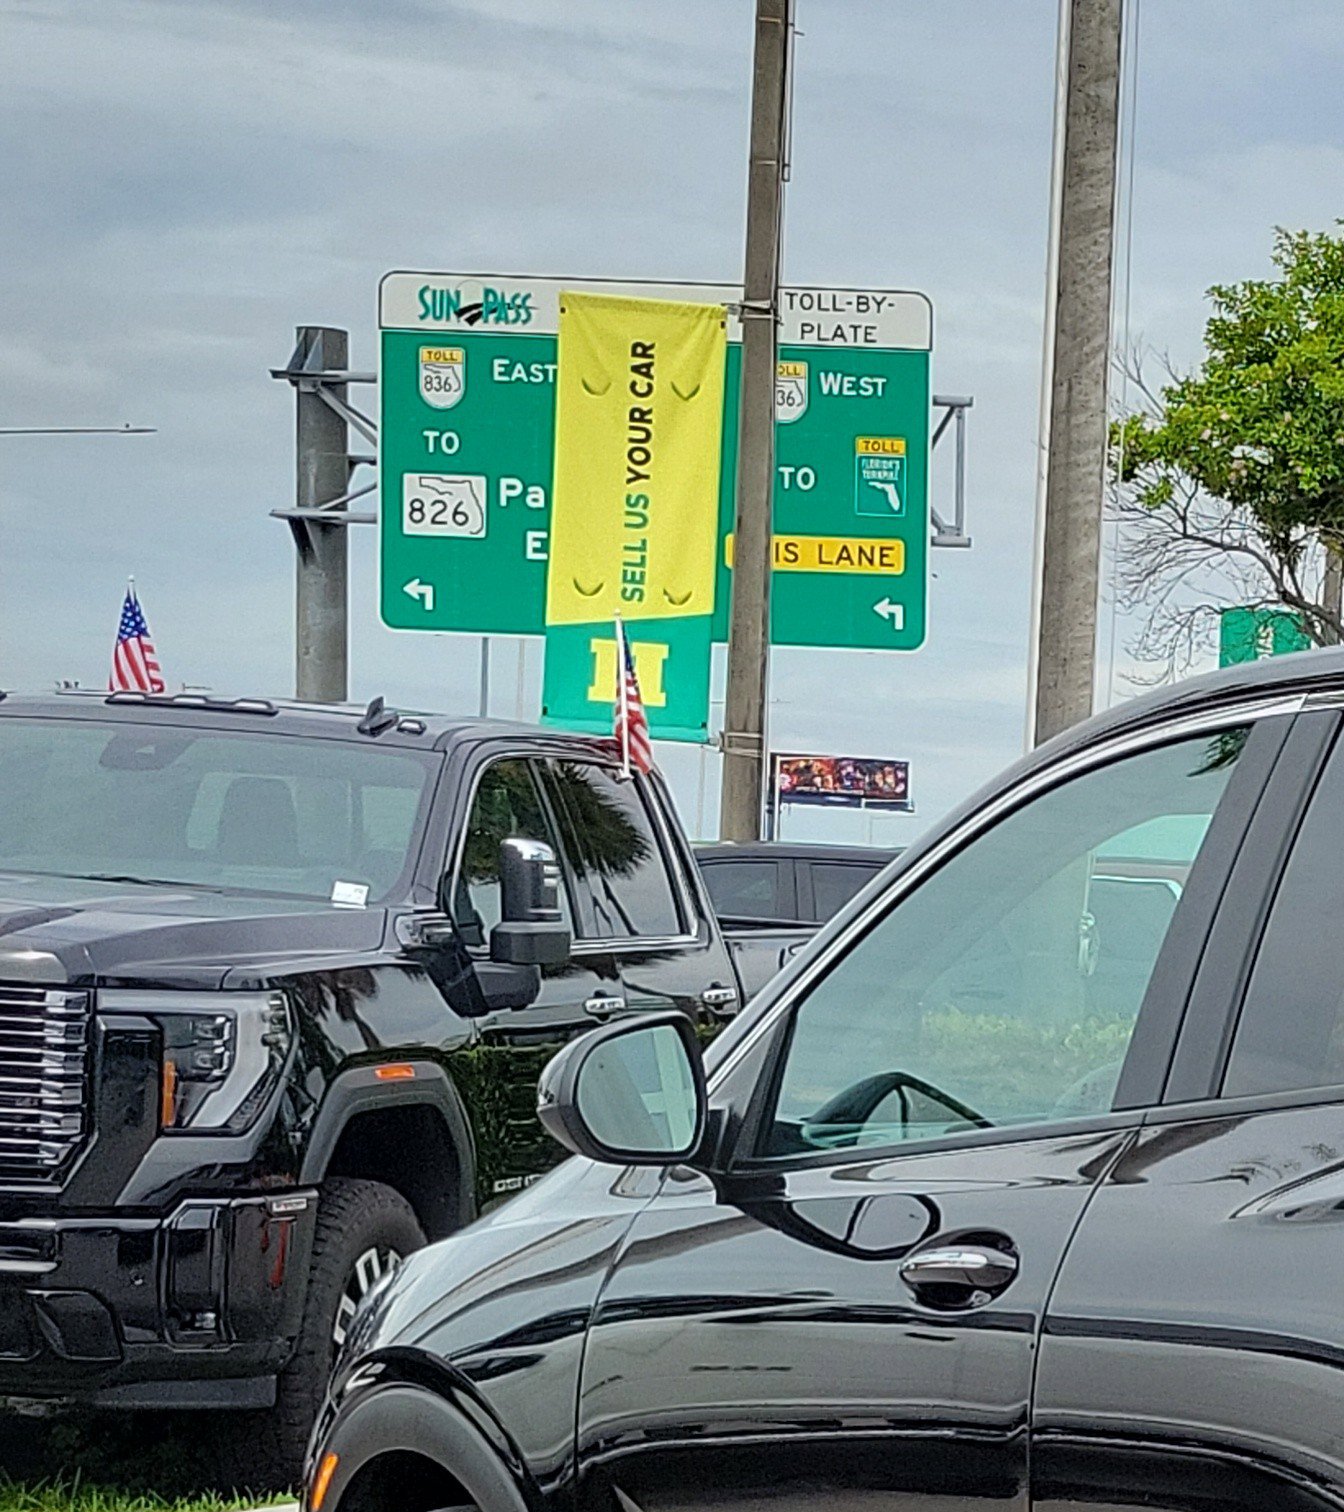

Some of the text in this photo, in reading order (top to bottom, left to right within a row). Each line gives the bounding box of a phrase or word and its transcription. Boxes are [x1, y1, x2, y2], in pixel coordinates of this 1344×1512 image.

[418, 285, 532, 325] SUN PASS
[785, 292, 895, 313] TOLL-BY-
[800, 323, 877, 343] PLATE
[426, 351, 458, 361] TOLL
[493, 358, 557, 383] EAST
[778, 366, 801, 375] OLL
[424, 375, 453, 392] 836
[819, 371, 887, 397] WEST
[776, 389, 796, 407] 36
[423, 430, 460, 454] TO
[863, 440, 899, 453] TOLL
[621, 340, 656, 603] SELL US YOUR CAR
[778, 466, 816, 491] TO
[408, 498, 469, 526] 826
[775, 542, 895, 567] IS LANE
